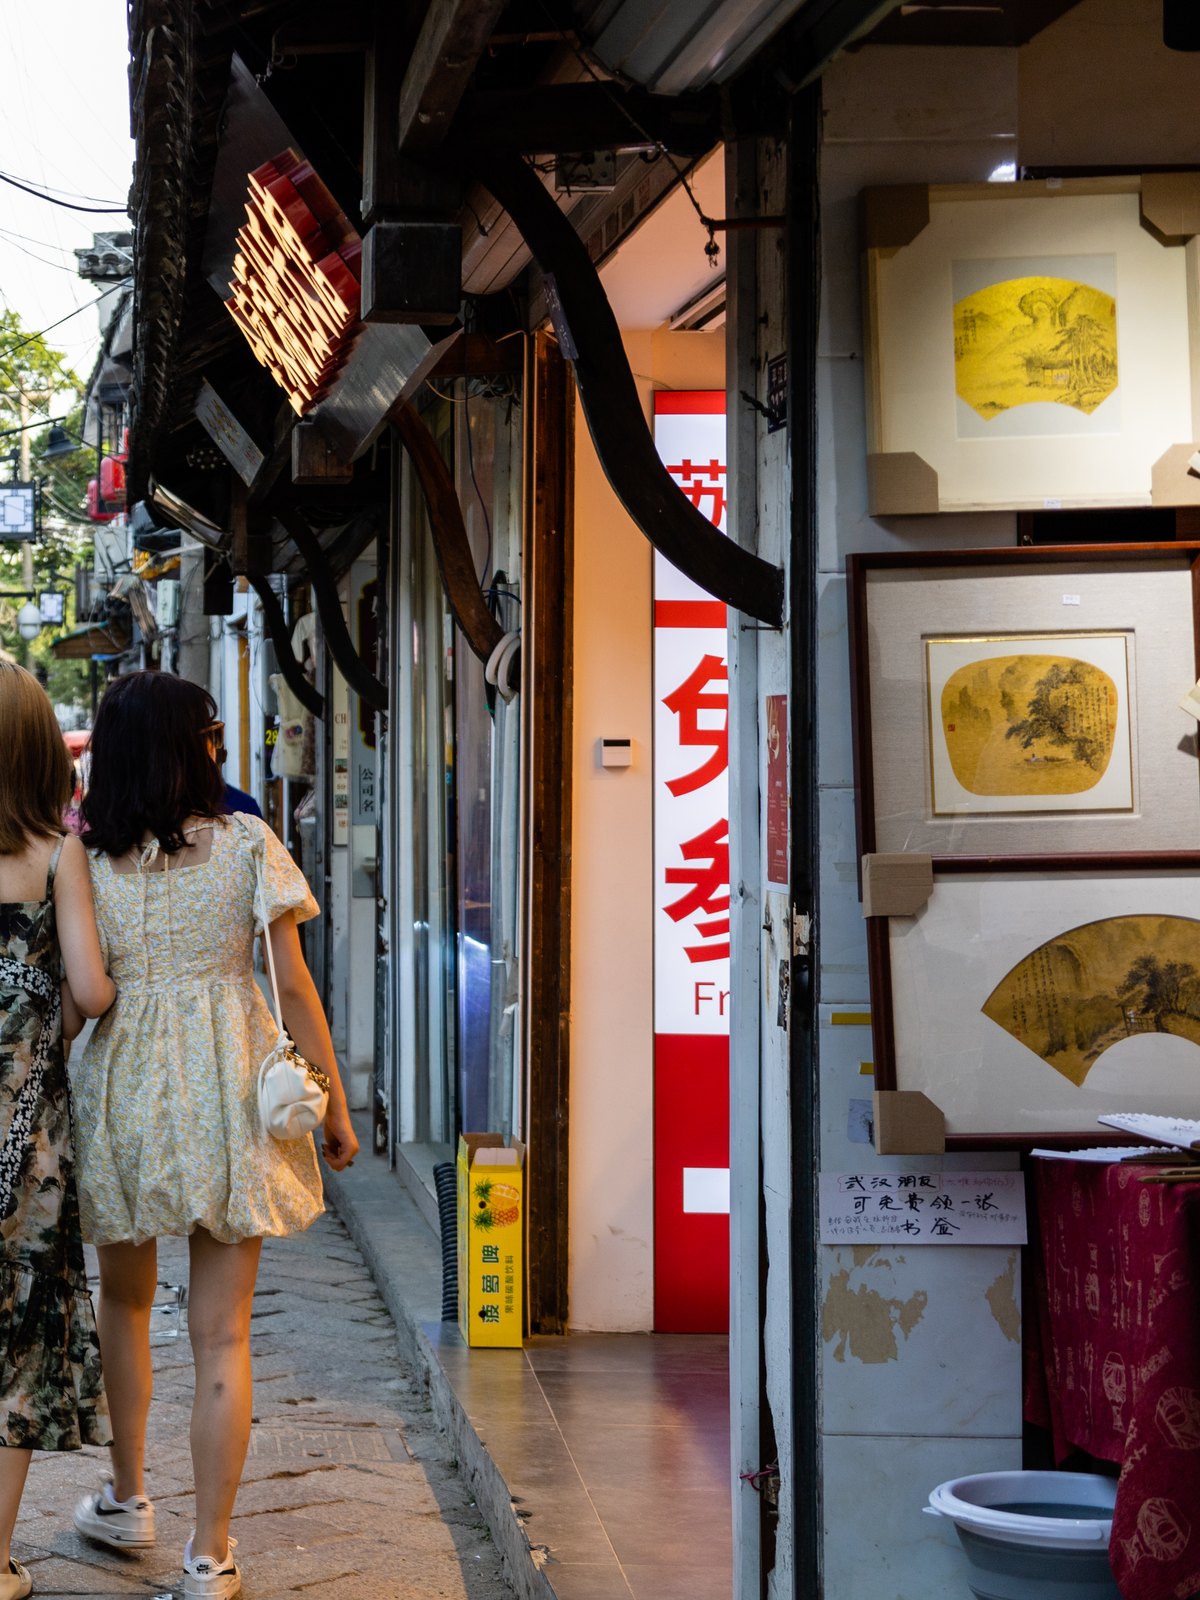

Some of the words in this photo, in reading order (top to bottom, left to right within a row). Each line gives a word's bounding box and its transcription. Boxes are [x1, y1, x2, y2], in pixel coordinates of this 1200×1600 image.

[845, 1175, 937, 1191] 武汉朋友
[853, 1192, 1000, 1214] 可免费领一张
